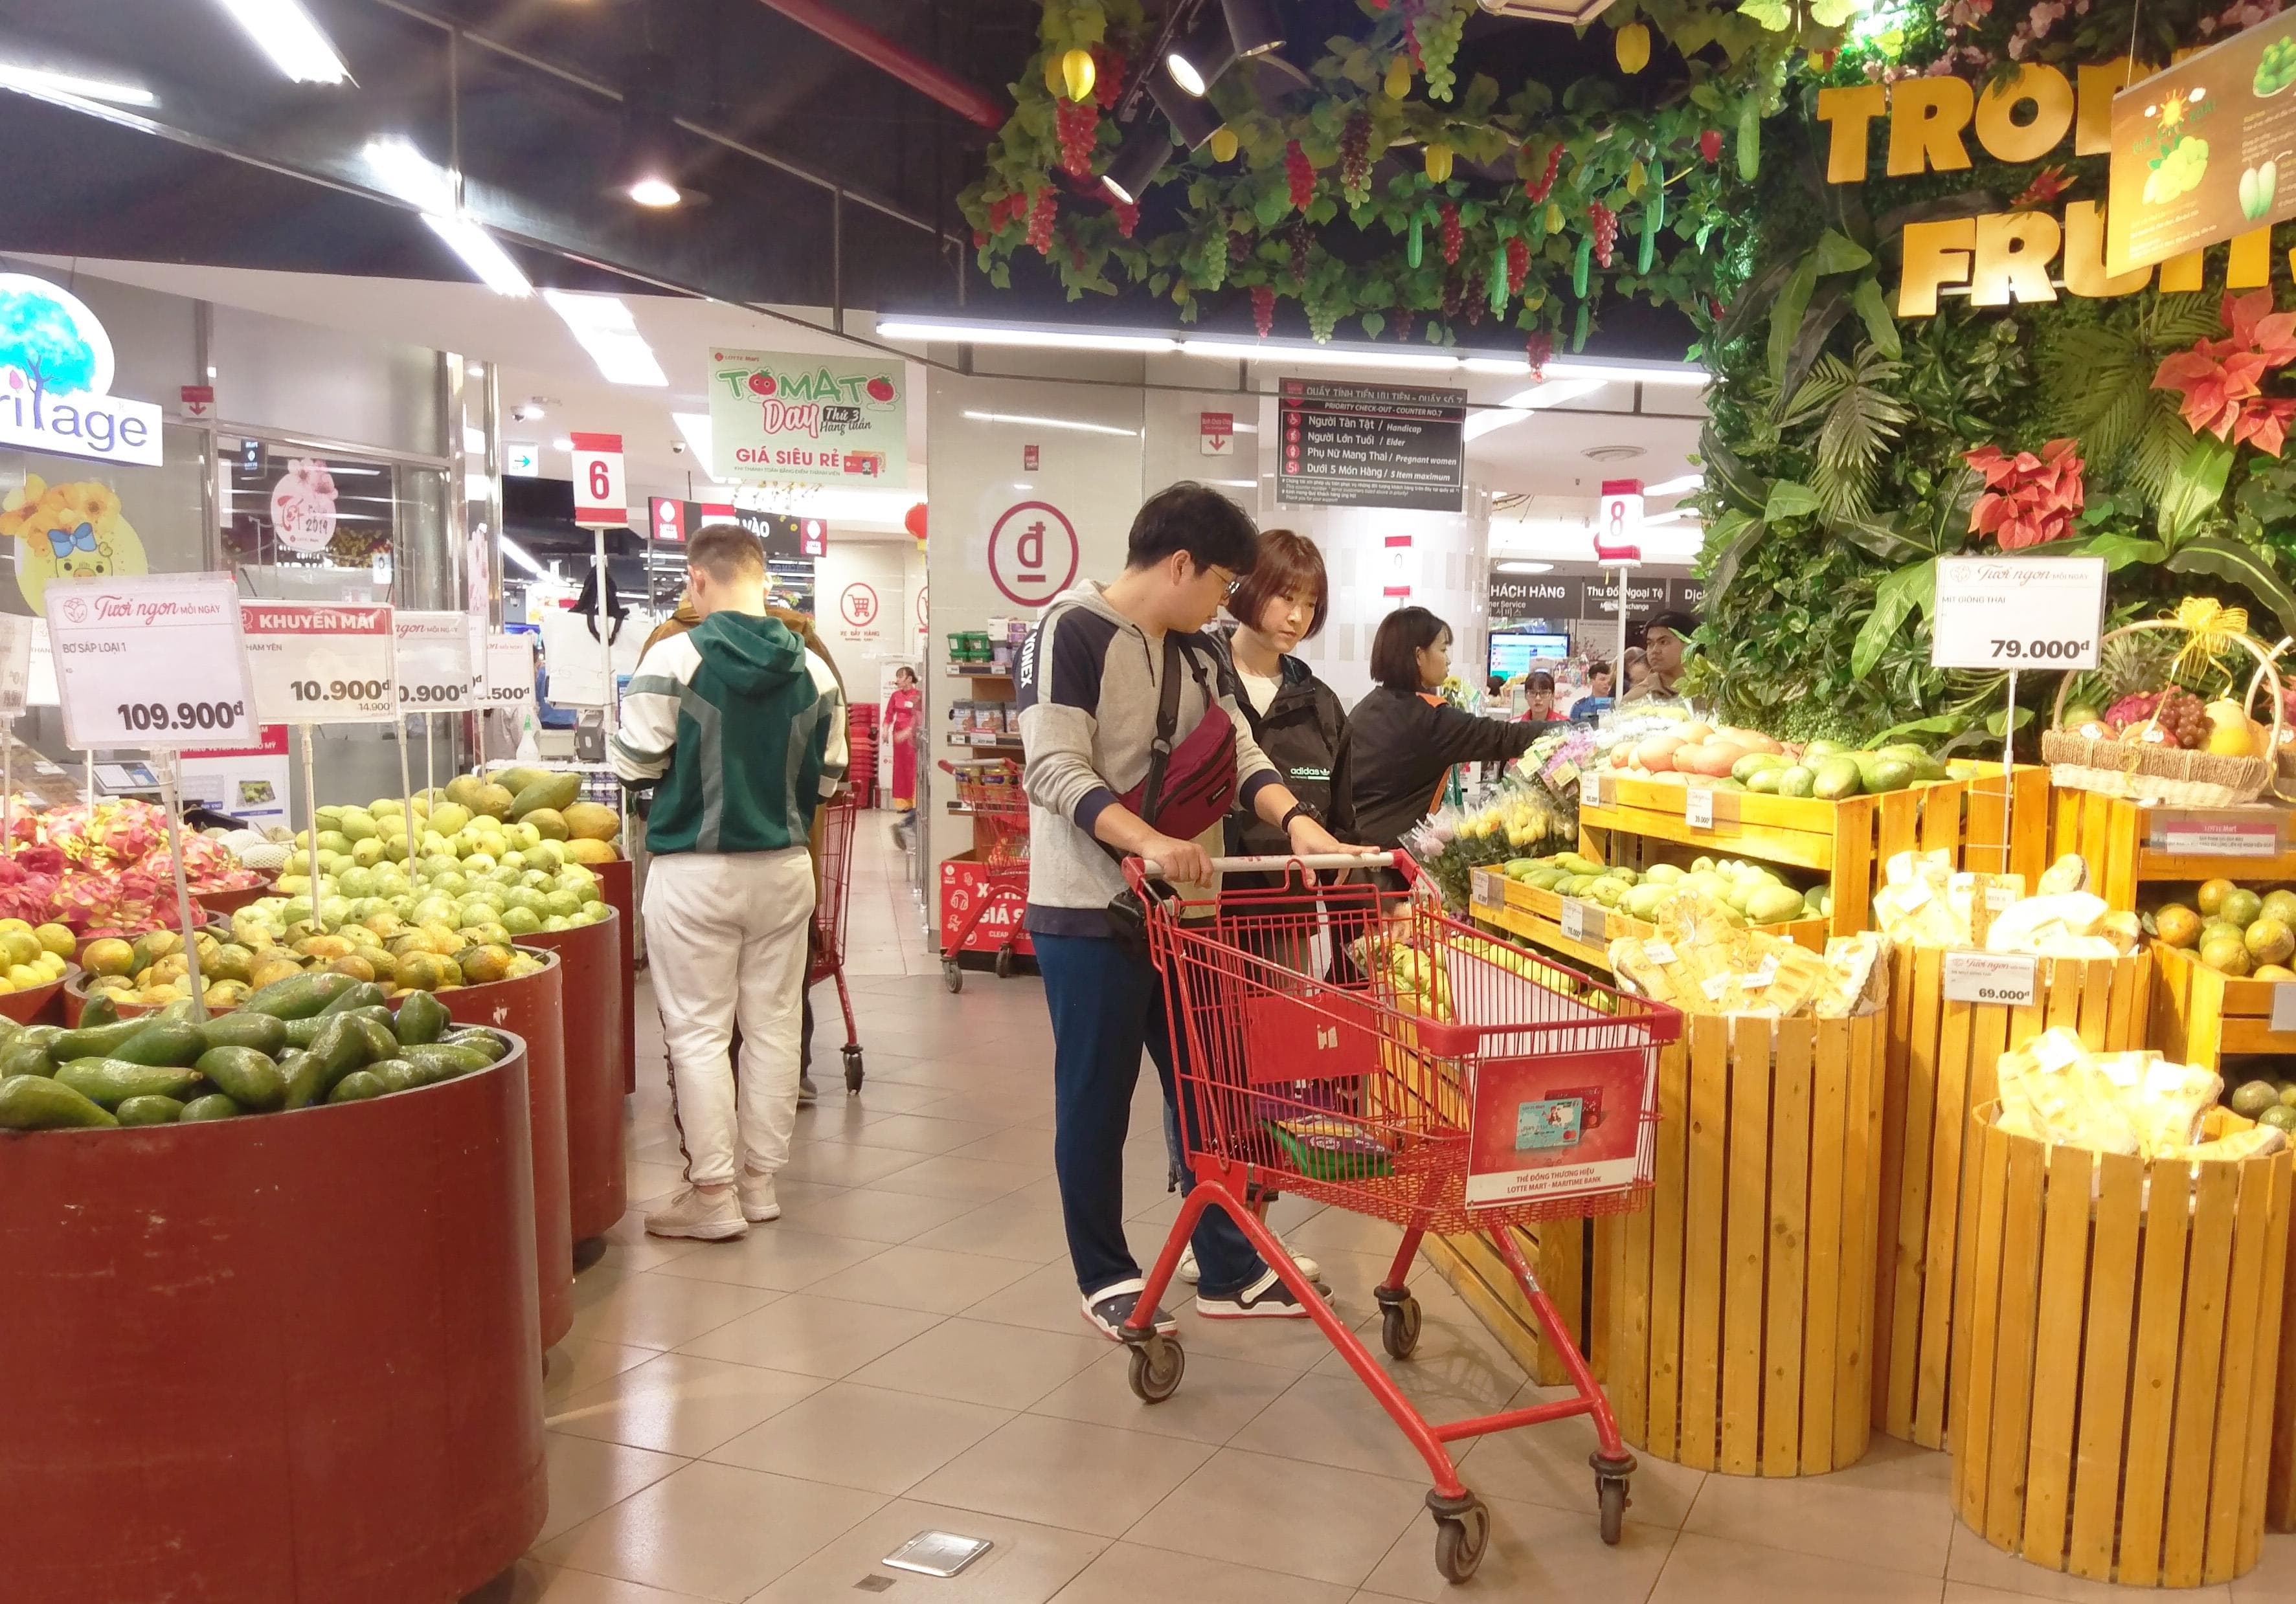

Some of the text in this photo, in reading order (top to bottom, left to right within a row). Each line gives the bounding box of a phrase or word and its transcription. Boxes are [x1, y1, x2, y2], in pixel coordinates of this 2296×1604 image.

[852, 409, 859, 421] 3
[1325, 402, 1354, 410] PRIORITY
[1396, 407, 1425, 415] COUNTER
[762, 399, 819, 438] Day
[1387, 423, 1422, 434] Handicap
[1386, 438, 1406, 446] Elder
[736, 446, 840, 467] GIÁ SIÊU RẺ
[1342, 450, 1366, 462] Mang
[1396, 454, 1429, 465] Pregnant
[589, 460, 610, 500] 6
[1331, 465, 1336, 474] 5
[1414, 473, 1450, 482] maximum
[1610, 500, 1626, 537] 8
[2013, 570, 2051, 586] ngon
[1529, 583, 1566, 599] HÀNG
[1587, 586, 1604, 597] Thu
[136, 601, 180, 625] ngon
[1626, 602, 1649, 611] xchange
[259, 611, 375, 629] KHUYẾN MÃI
[78, 641, 96, 653] SÁP
[121, 642, 126, 652] 1
[1990, 640, 2090, 660] 79.000đ
[1021, 632, 1037, 689] YONEX
[118, 700, 244, 731] 109.900đ
[1290, 766, 1320, 775] adidas
[1979, 988, 2030, 1000] 69.000đ
[1507, 1185, 1527, 1194] LOTTE
[1529, 1183, 1547, 1191] MART
[1552, 1178, 1583, 1188] MARITIME
[1584, 1176, 1601, 1185] BANK
